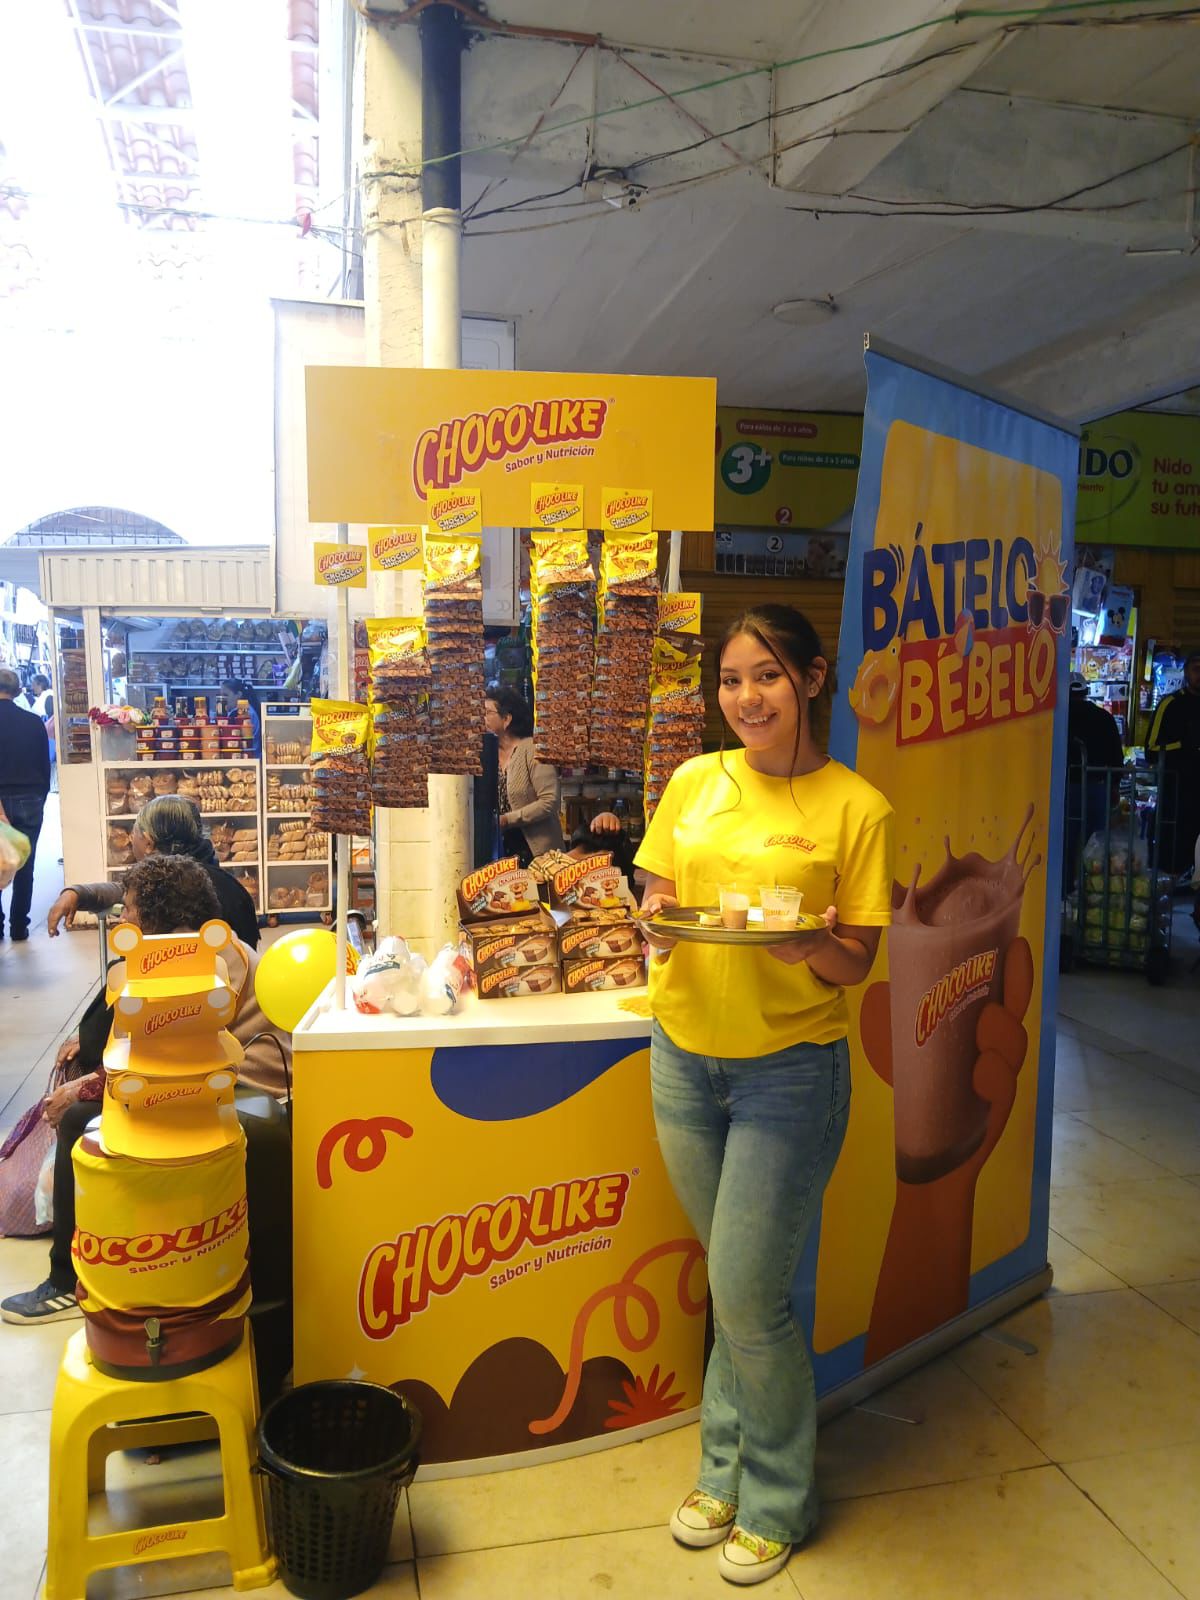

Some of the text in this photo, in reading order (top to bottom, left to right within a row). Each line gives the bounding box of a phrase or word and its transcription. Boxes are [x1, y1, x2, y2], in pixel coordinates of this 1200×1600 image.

[414, 399, 608, 500] CHOCOLIKE
[505, 445, 595, 473] Sabor y Nutrición
[728, 446, 772, 484] 3+
[1153, 457, 1193, 475] Nido
[1152, 479, 1169, 494] tu
[431, 496, 476, 520] CHOCOLIKE
[534, 492, 578, 514] CHOCOLIKE
[605, 496, 649, 518] CHOCOLIKE
[1151, 502, 1170, 515] su
[439, 513, 466, 527] CHOCO
[540, 508, 567, 522] CHOCO
[779, 509, 790, 525] 2
[372, 532, 417, 558] CHOCOLIKE
[771, 537, 779, 550] 2
[318, 551, 363, 573] CHOCOLIKE
[379, 551, 408, 567] CHOCO
[324, 568, 352, 581] CHOCO
[862, 522, 1037, 654] BÁTELO
[658, 600, 697, 621] HOCOLIKE
[901, 629, 1056, 740] BÉBELO
[462, 856, 519, 902] CHOCOLIKE
[554, 853, 612, 896] CHOCOLIKE
[139, 943, 198, 974] CHOCOLIKE
[915, 951, 997, 1048] CHOCOLIKE
[144, 1005, 202, 1035] CHOCOLIKE
[143, 1088, 202, 1109] CHOCOLIKE
[128, 1258, 178, 1274] Sabor
[182, 1255, 193, 1264] y
[357, 1172, 630, 1341] CHOCOLIKE
[489, 1236, 613, 1290] Sabor y Nutrición
